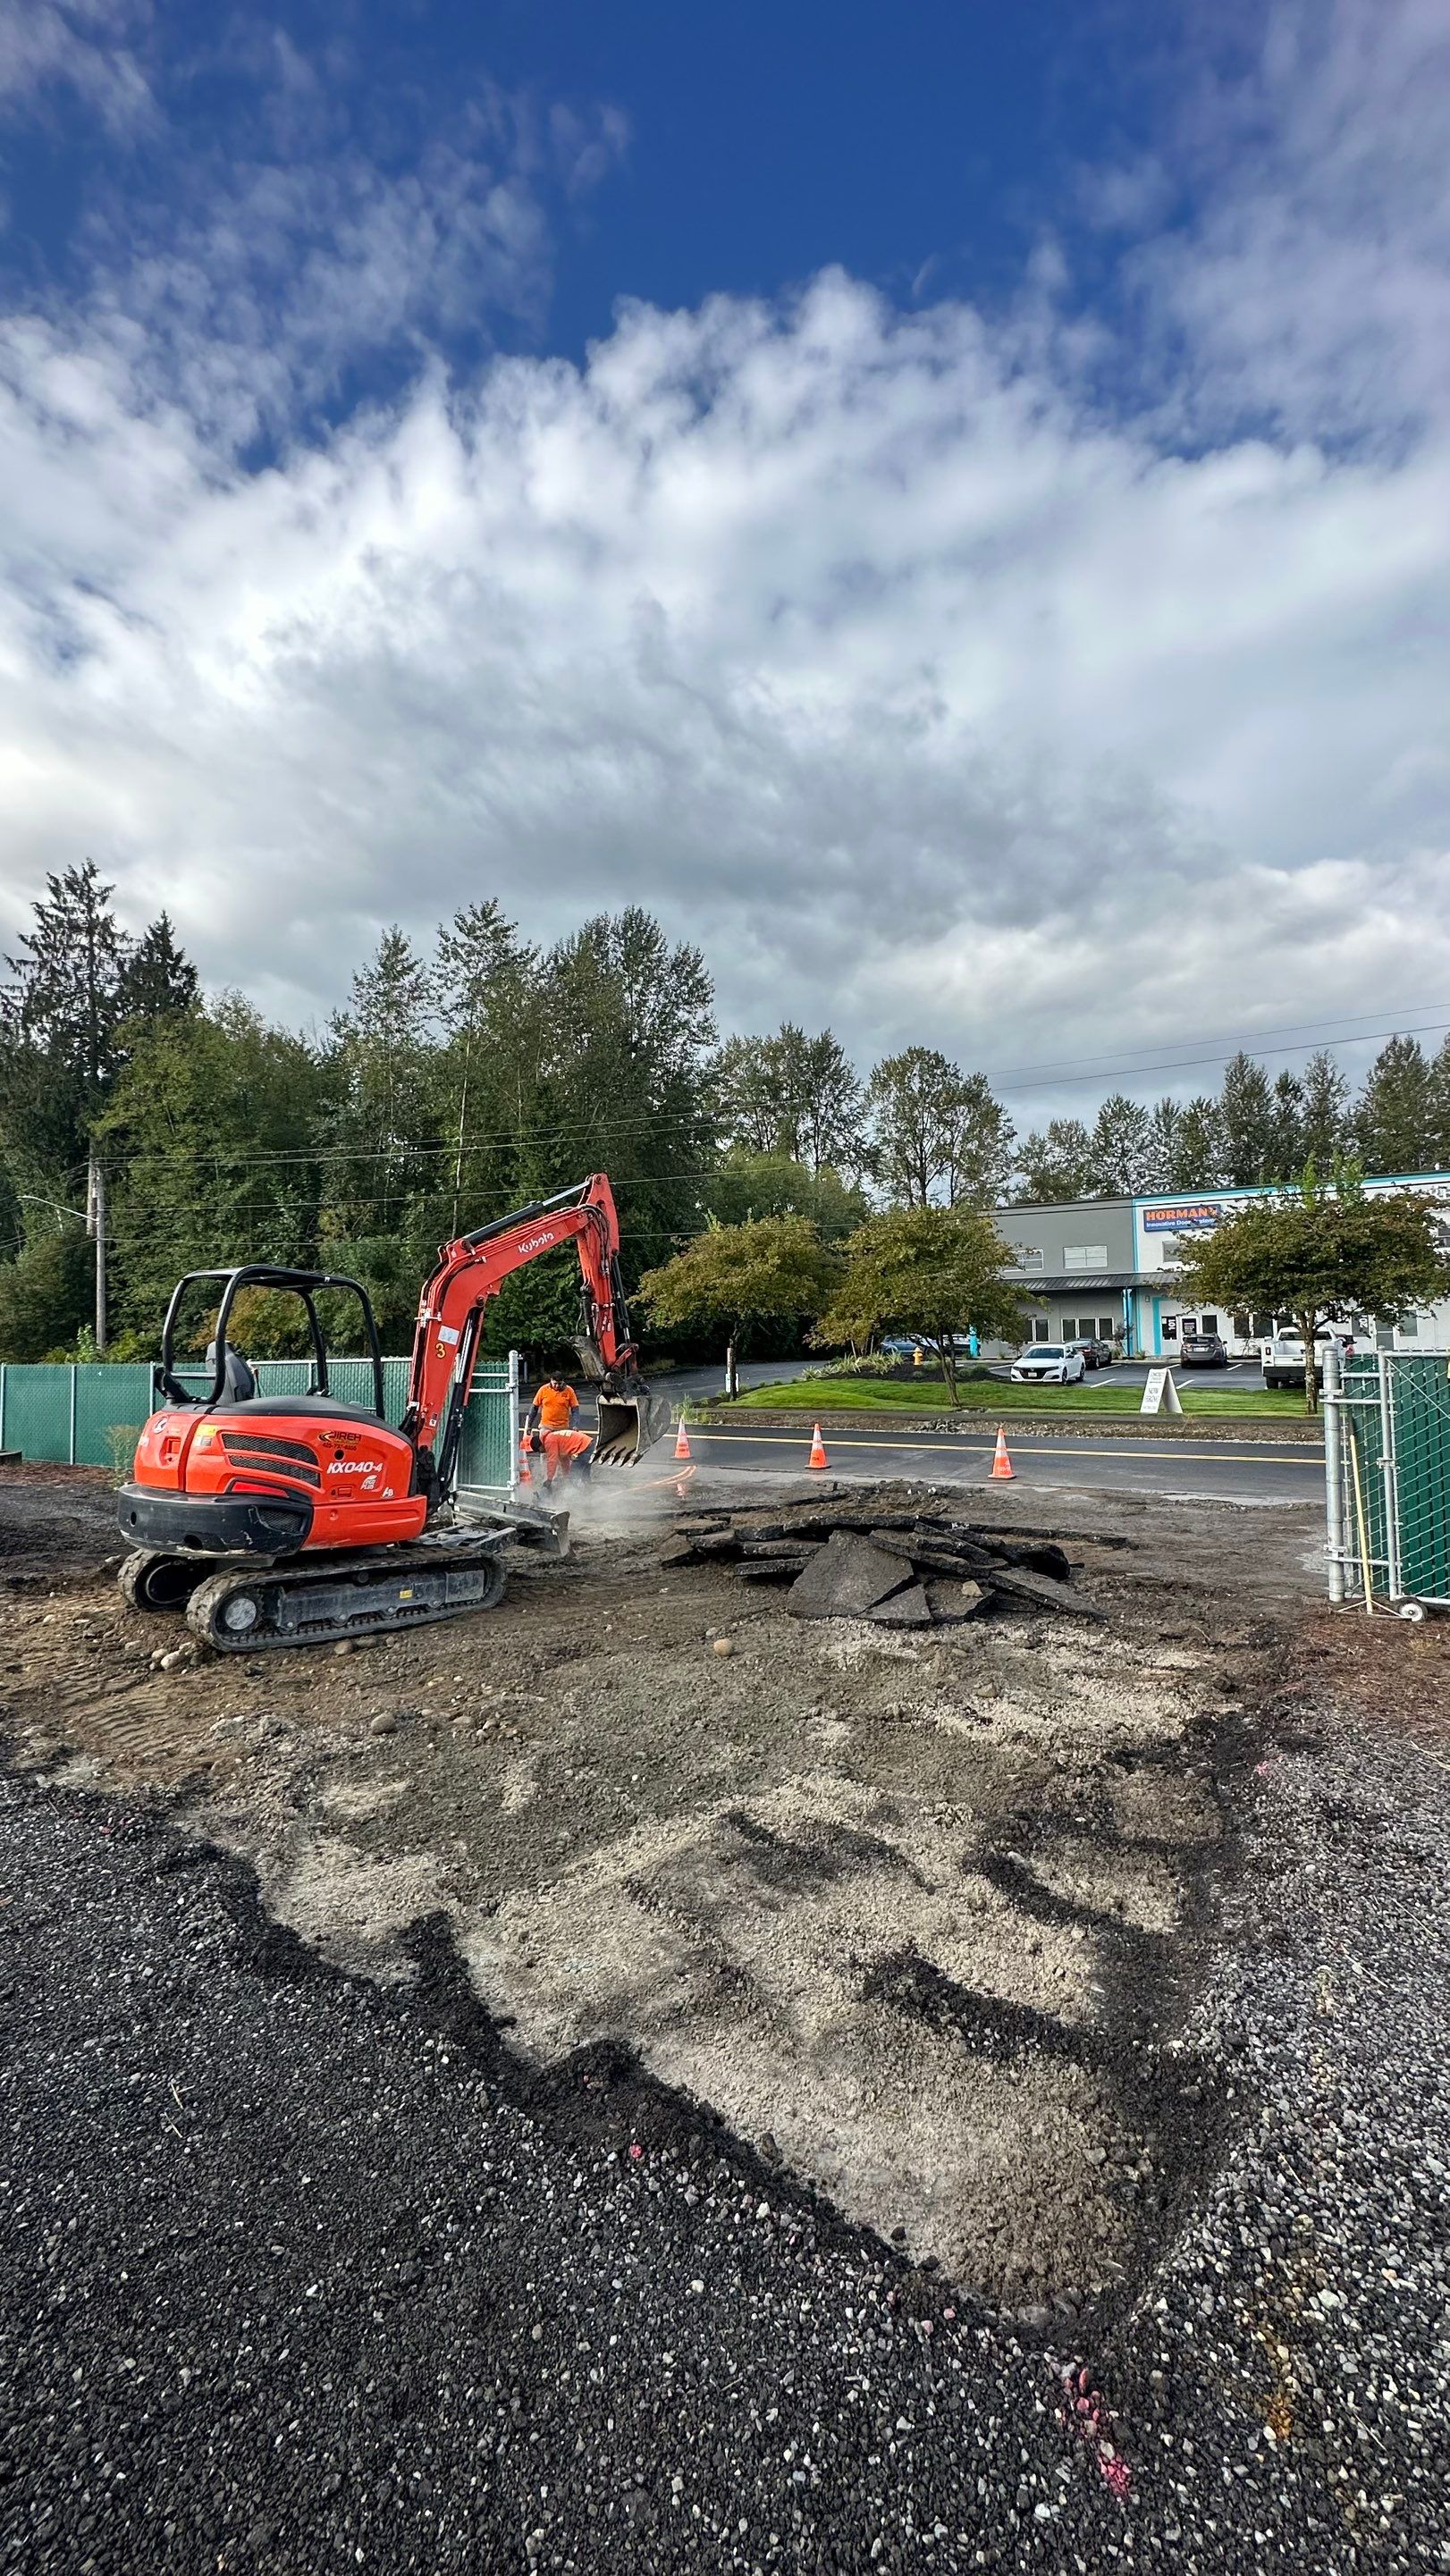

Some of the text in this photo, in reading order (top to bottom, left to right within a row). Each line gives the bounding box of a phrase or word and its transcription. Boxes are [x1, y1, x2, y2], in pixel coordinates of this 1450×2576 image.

[518, 1233, 554, 1253] Kubota
[1168, 1318, 1176, 1331] 101
[435, 1343, 446, 1359] 3
[328, 1431, 362, 1441] JIREH
[326, 1461, 384, 1474] KX040-4
